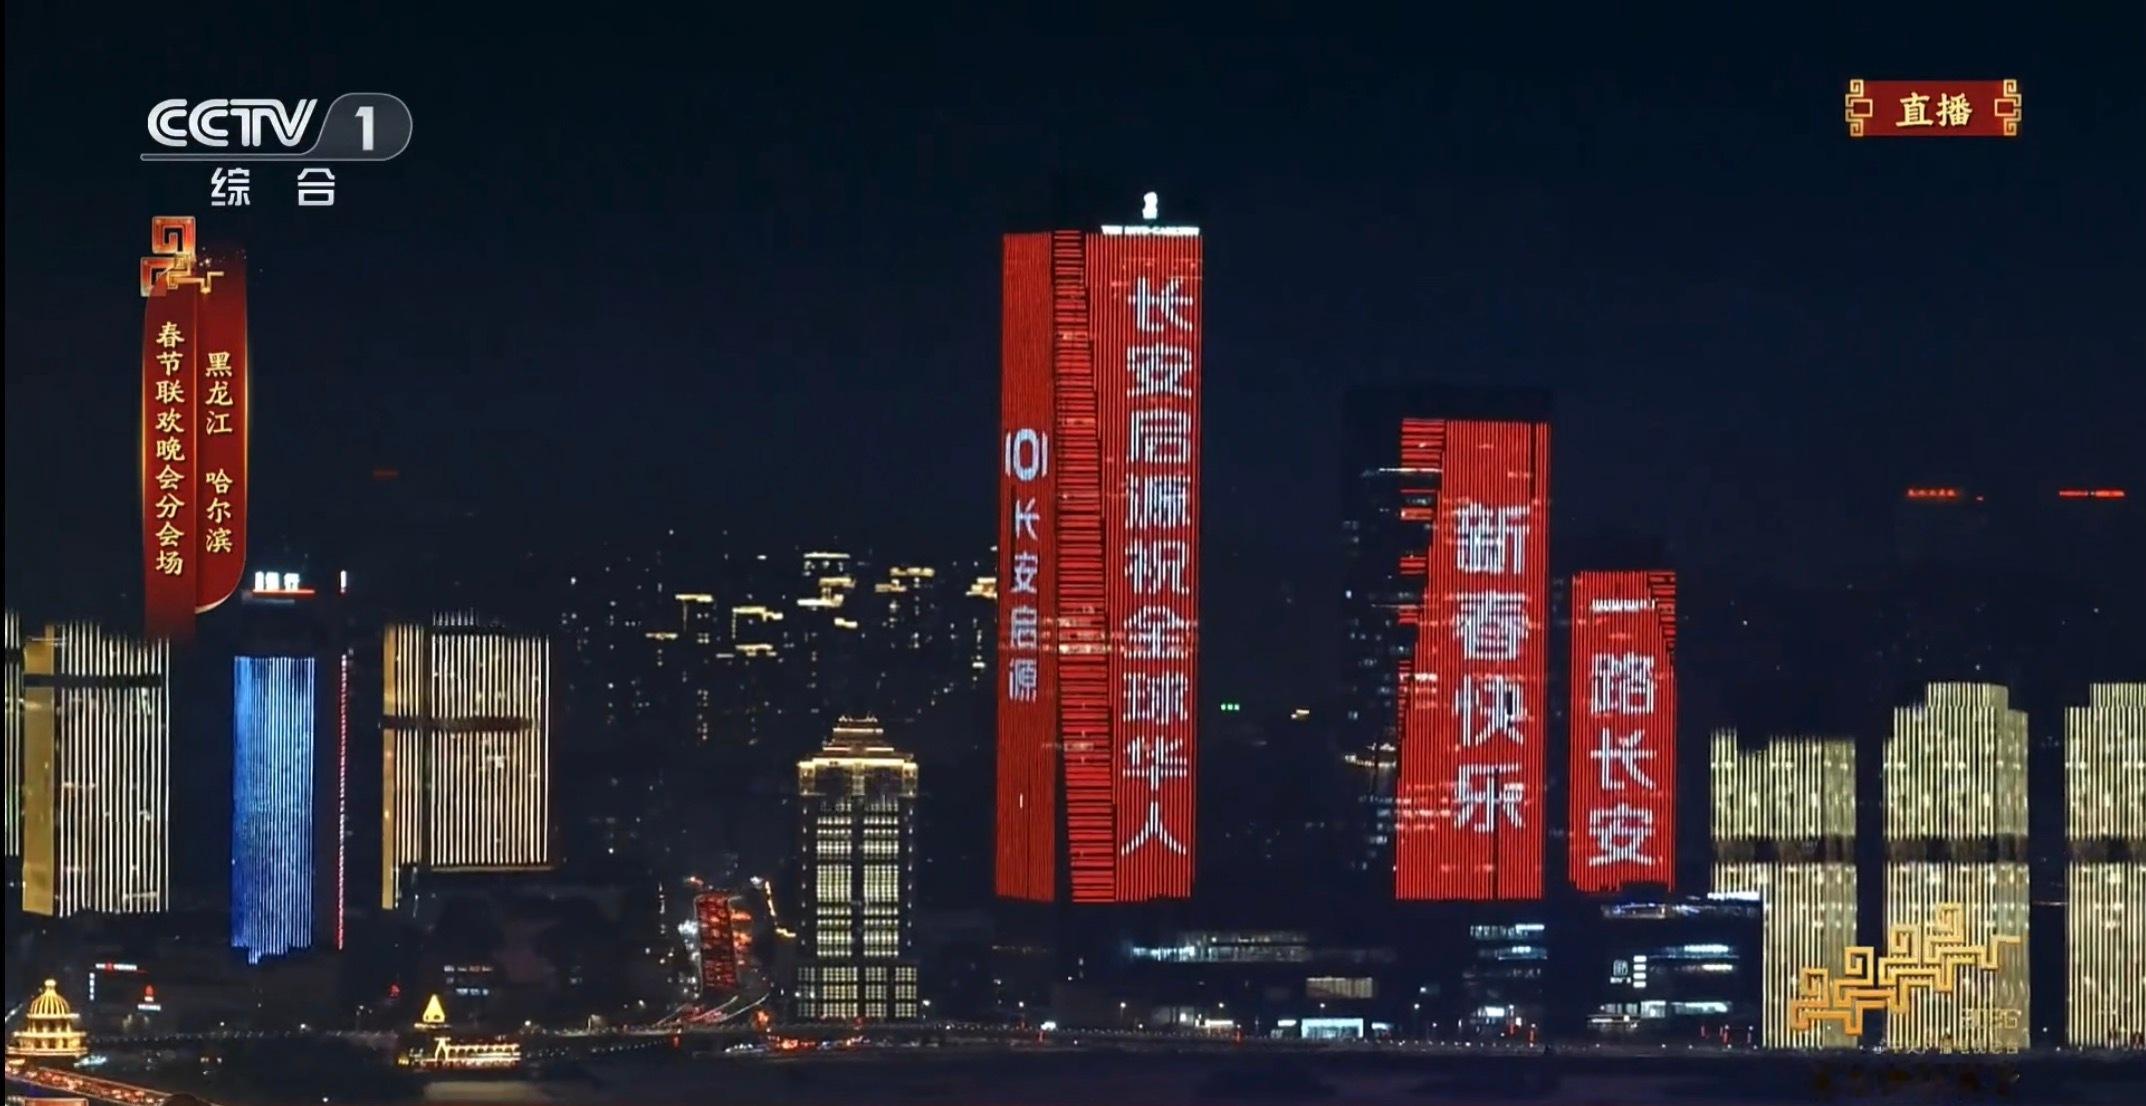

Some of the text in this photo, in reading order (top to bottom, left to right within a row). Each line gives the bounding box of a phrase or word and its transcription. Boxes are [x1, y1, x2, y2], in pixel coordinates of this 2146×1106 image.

[1008, 497, 1040, 703] 长安启源
[1120, 275, 1194, 856] 长安启源祝全球华人
[1452, 501, 1531, 834] 新春快乐
[1588, 598, 1658, 868] 一路长安
